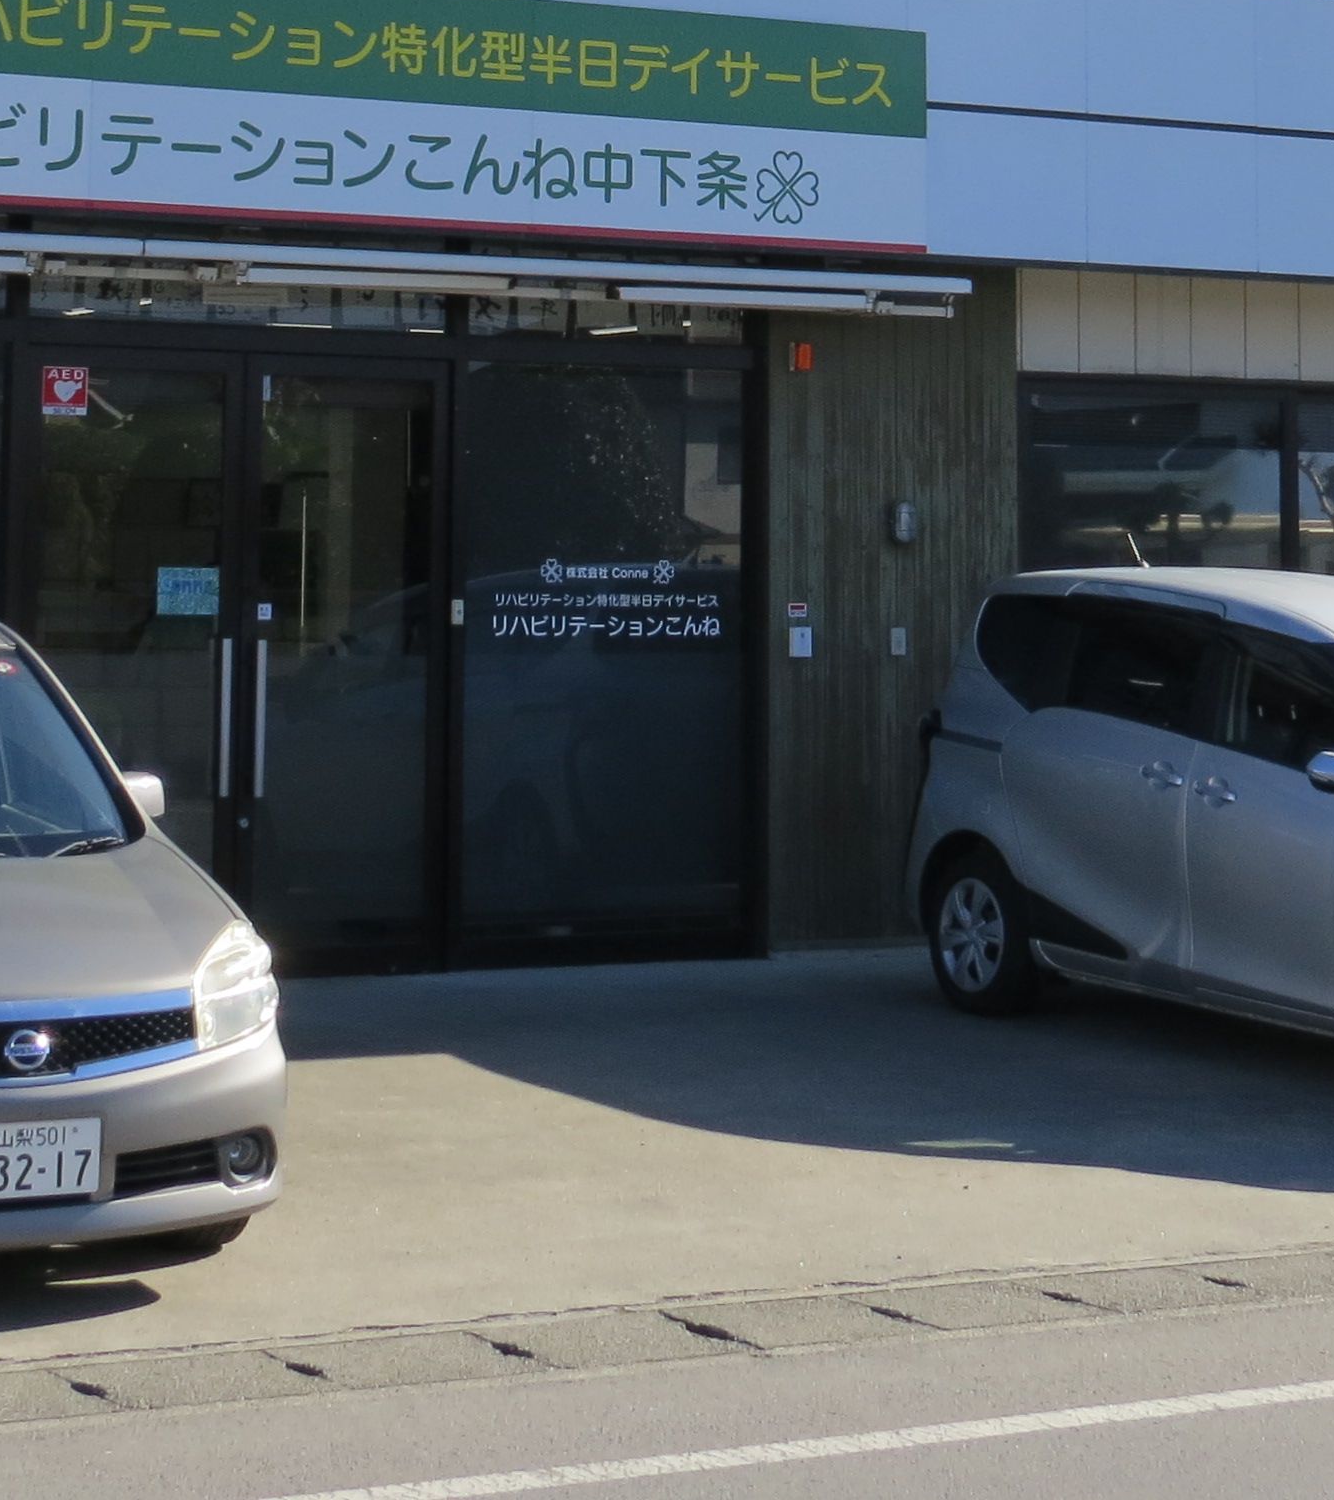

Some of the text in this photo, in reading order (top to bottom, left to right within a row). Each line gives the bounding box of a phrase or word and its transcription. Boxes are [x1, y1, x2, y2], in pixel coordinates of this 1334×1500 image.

[47, 368, 84, 380] AED
[611, 566, 649, 579] Conne
[494, 593, 720, 608] リハビリテーション特化型半日デイサービス
[492, 614, 721, 638] リハビリテーションこんね
